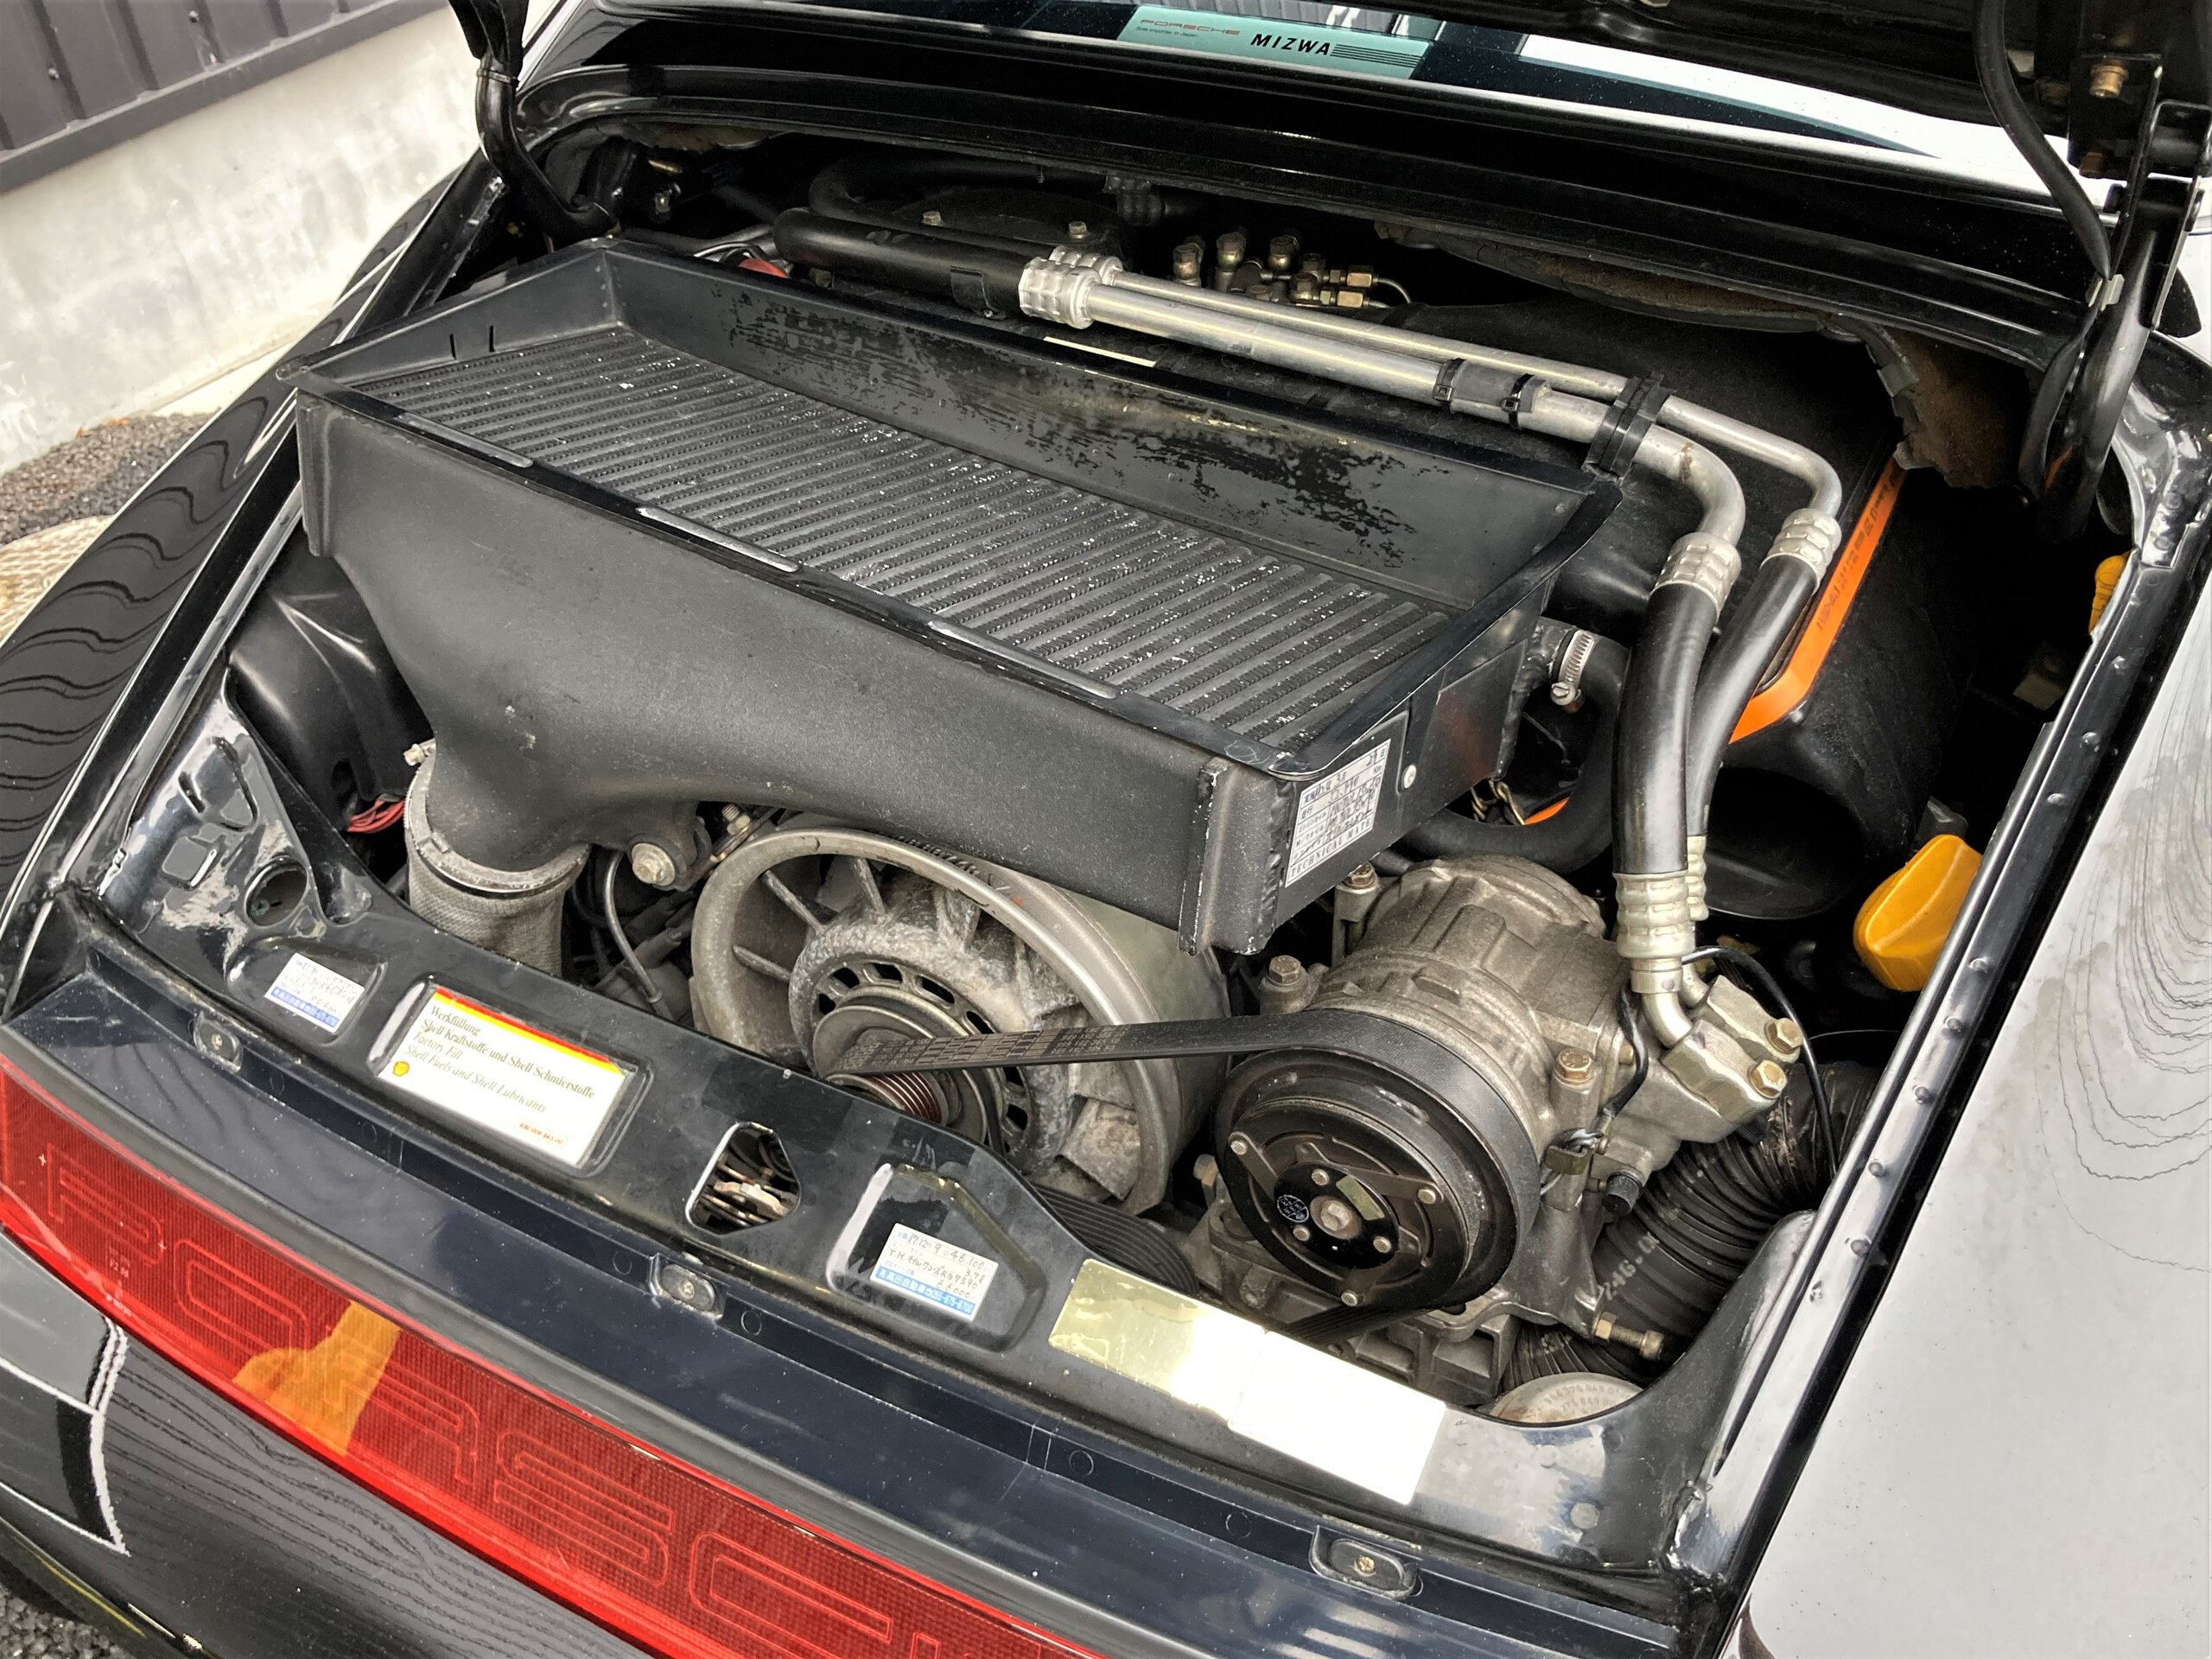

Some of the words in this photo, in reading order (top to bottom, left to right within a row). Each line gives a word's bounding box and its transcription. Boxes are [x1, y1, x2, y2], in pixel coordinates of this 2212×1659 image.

[1140, 18, 1241, 35] PORSCHE
[1249, 32, 1332, 56] MIZWA
[1291, 837, 1344, 878] TECHNICAL
[1348, 817, 1372, 838] MATE
[430, 1005, 481, 1037] Werkfüllung
[412, 1032, 443, 1052] Factory
[446, 1045, 464, 1060] Fill
[444, 1027, 489, 1054] Kraftstoffe
[489, 1048, 513, 1063] und
[508, 1056, 534, 1074] Shell
[535, 1065, 595, 1100] Schmierstoffe
[404, 1045, 433, 1064] Shell
[431, 1053, 452, 1072] Fuels
[452, 1064, 471, 1081] and
[471, 1070, 499, 1091] Shell
[497, 1084, 548, 1114] Lubricants
[47, 1141, 955, 1659] PORSC
